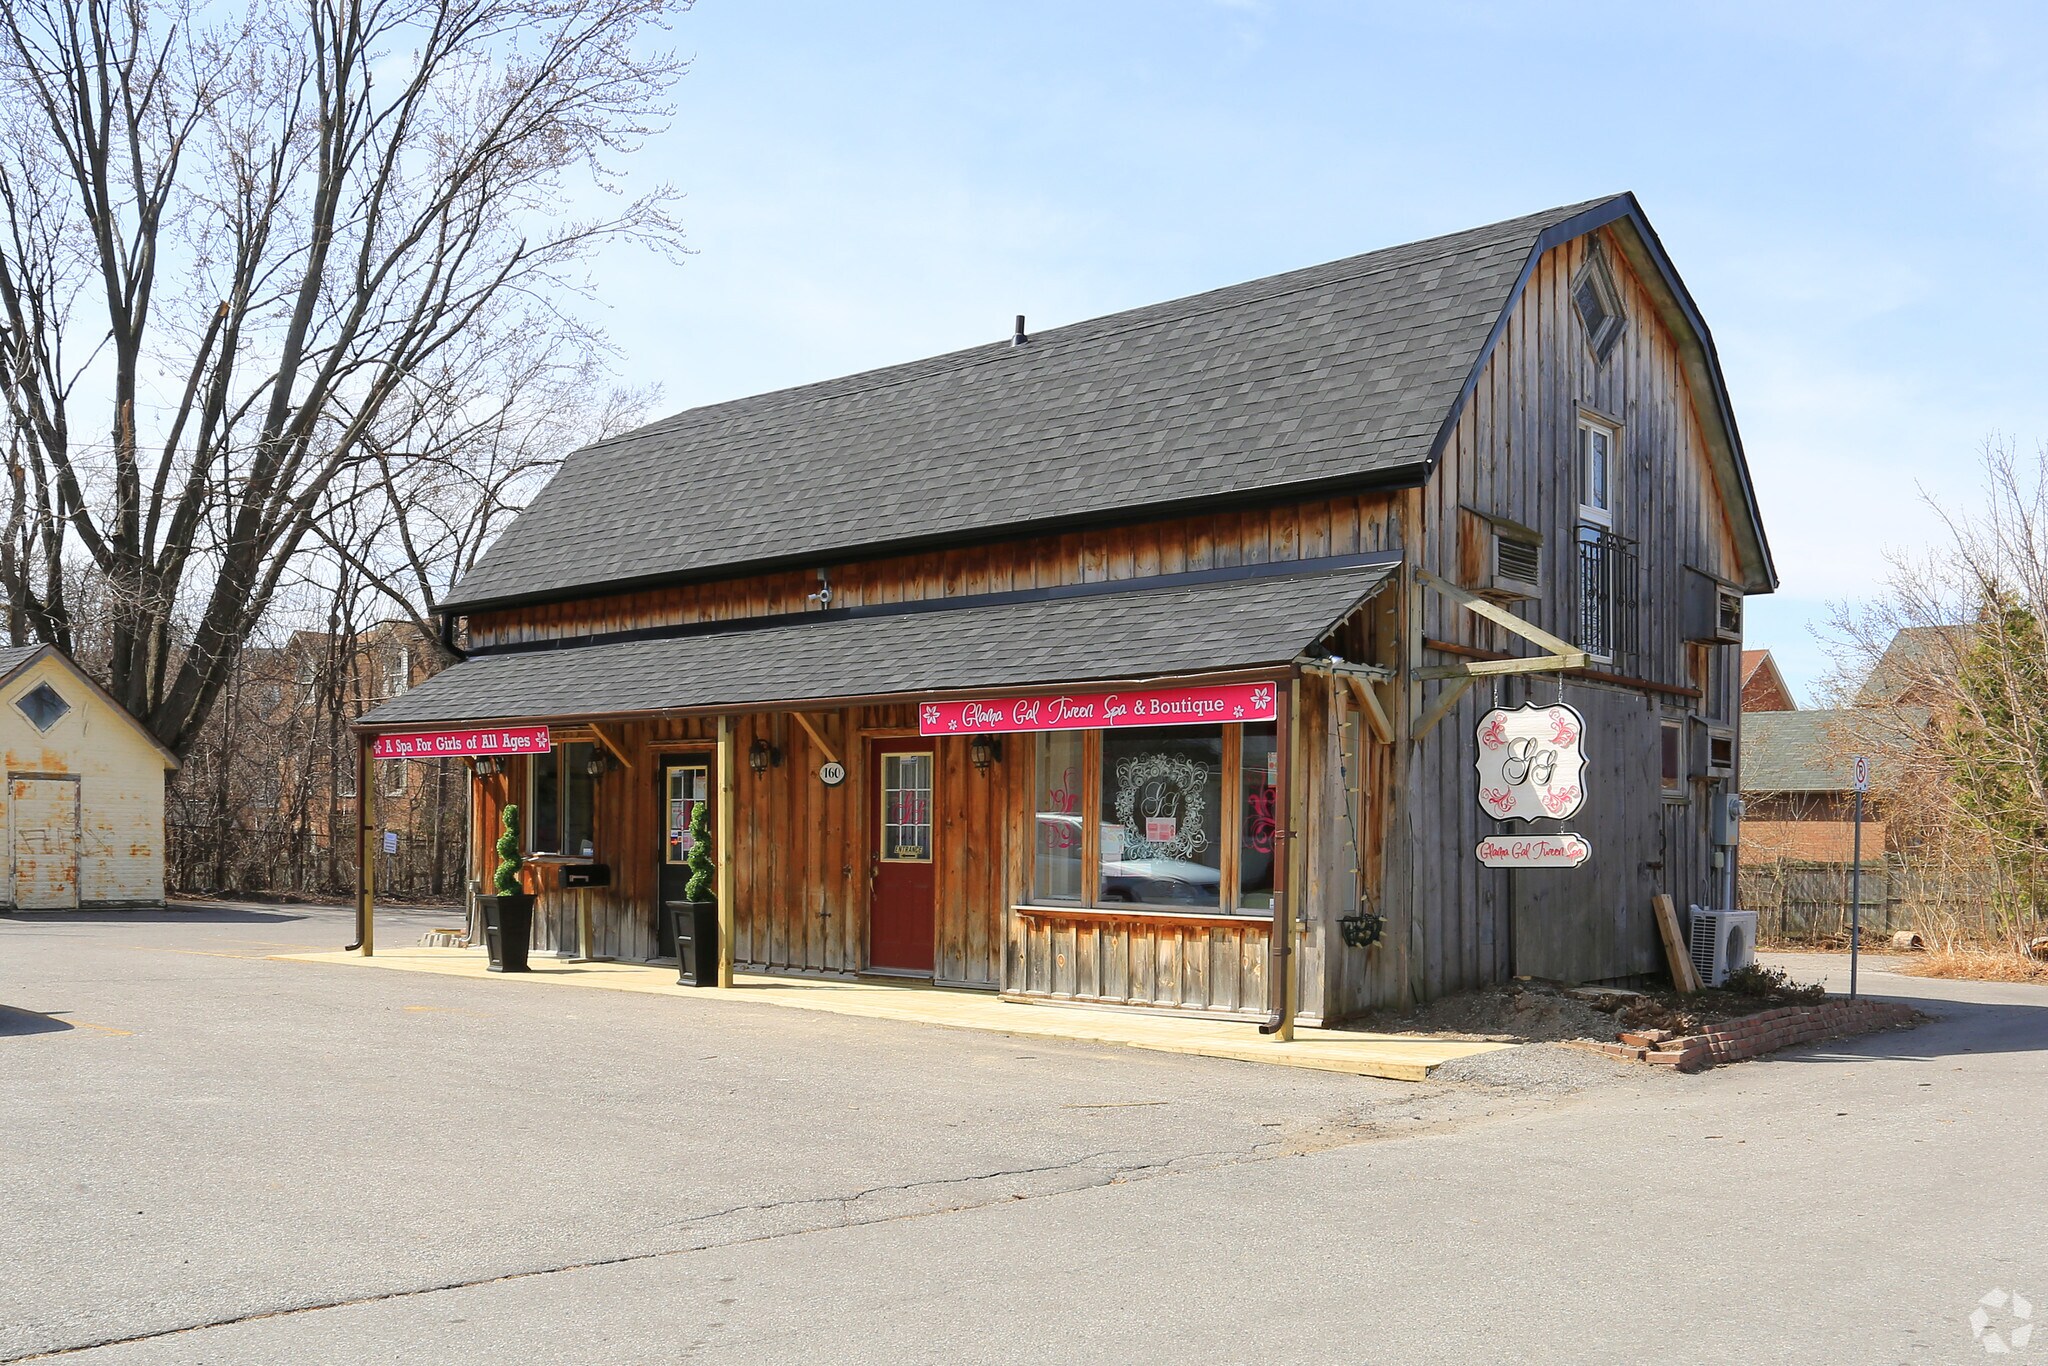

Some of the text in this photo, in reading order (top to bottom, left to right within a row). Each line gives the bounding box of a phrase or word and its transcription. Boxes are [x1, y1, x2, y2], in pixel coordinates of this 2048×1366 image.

[1012, 700, 1040, 725] Gal
[1048, 696, 1094, 724] Tween
[1102, 694, 1127, 726] Spa
[1134, 699, 1146, 715] &
[1149, 697, 1225, 717] Boutique
[385, 733, 531, 756] A Spa For Girls of All Ages
[823, 767, 840, 779] 160
[894, 845, 924, 854] ENTRANCE
[1512, 841, 1530, 860] Gal
[1533, 840, 1565, 860] Tween
[1566, 841, 1584, 862] Spa
